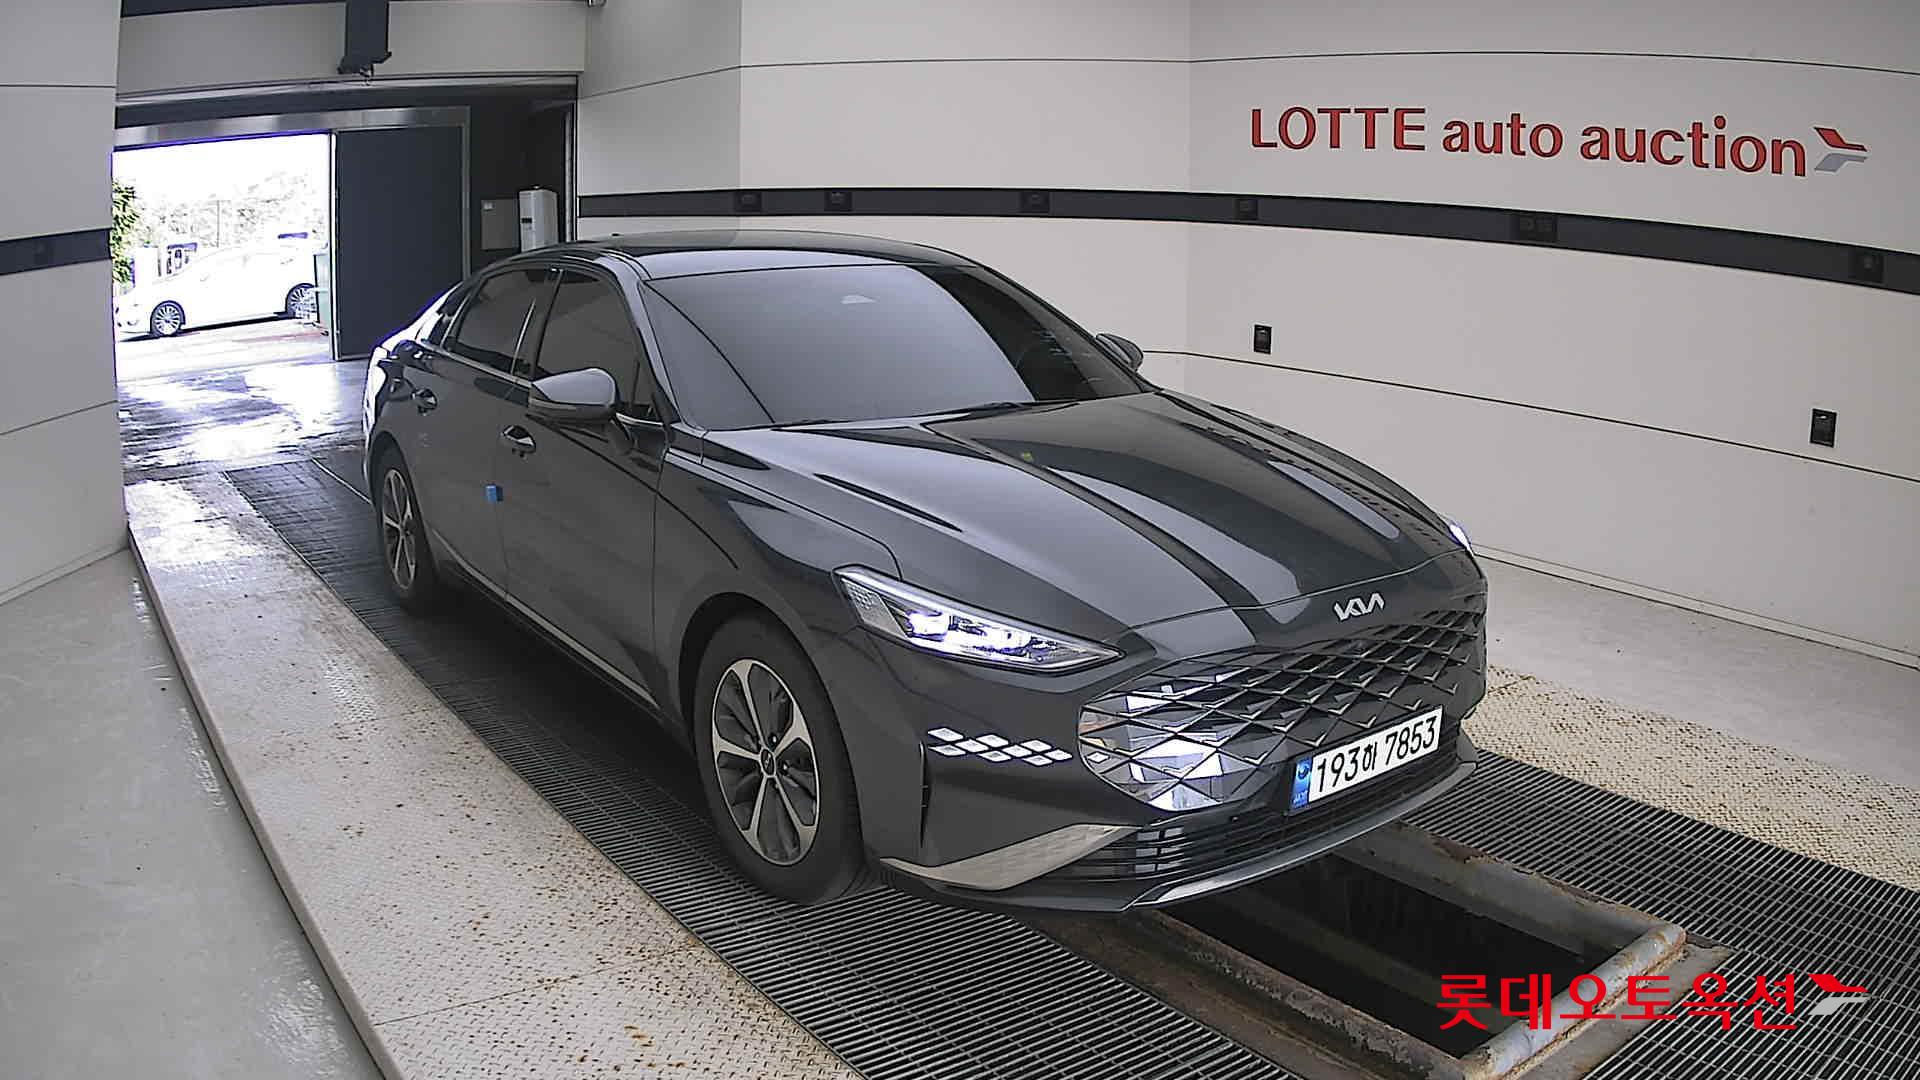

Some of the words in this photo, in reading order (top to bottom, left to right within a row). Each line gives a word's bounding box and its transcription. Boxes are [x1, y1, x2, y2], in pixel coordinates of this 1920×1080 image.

[1251, 107, 1426, 151] LOTTE
[1441, 112, 1564, 159] auto
[1579, 115, 1807, 177] auction
[1385, 715, 1437, 766] 7853
